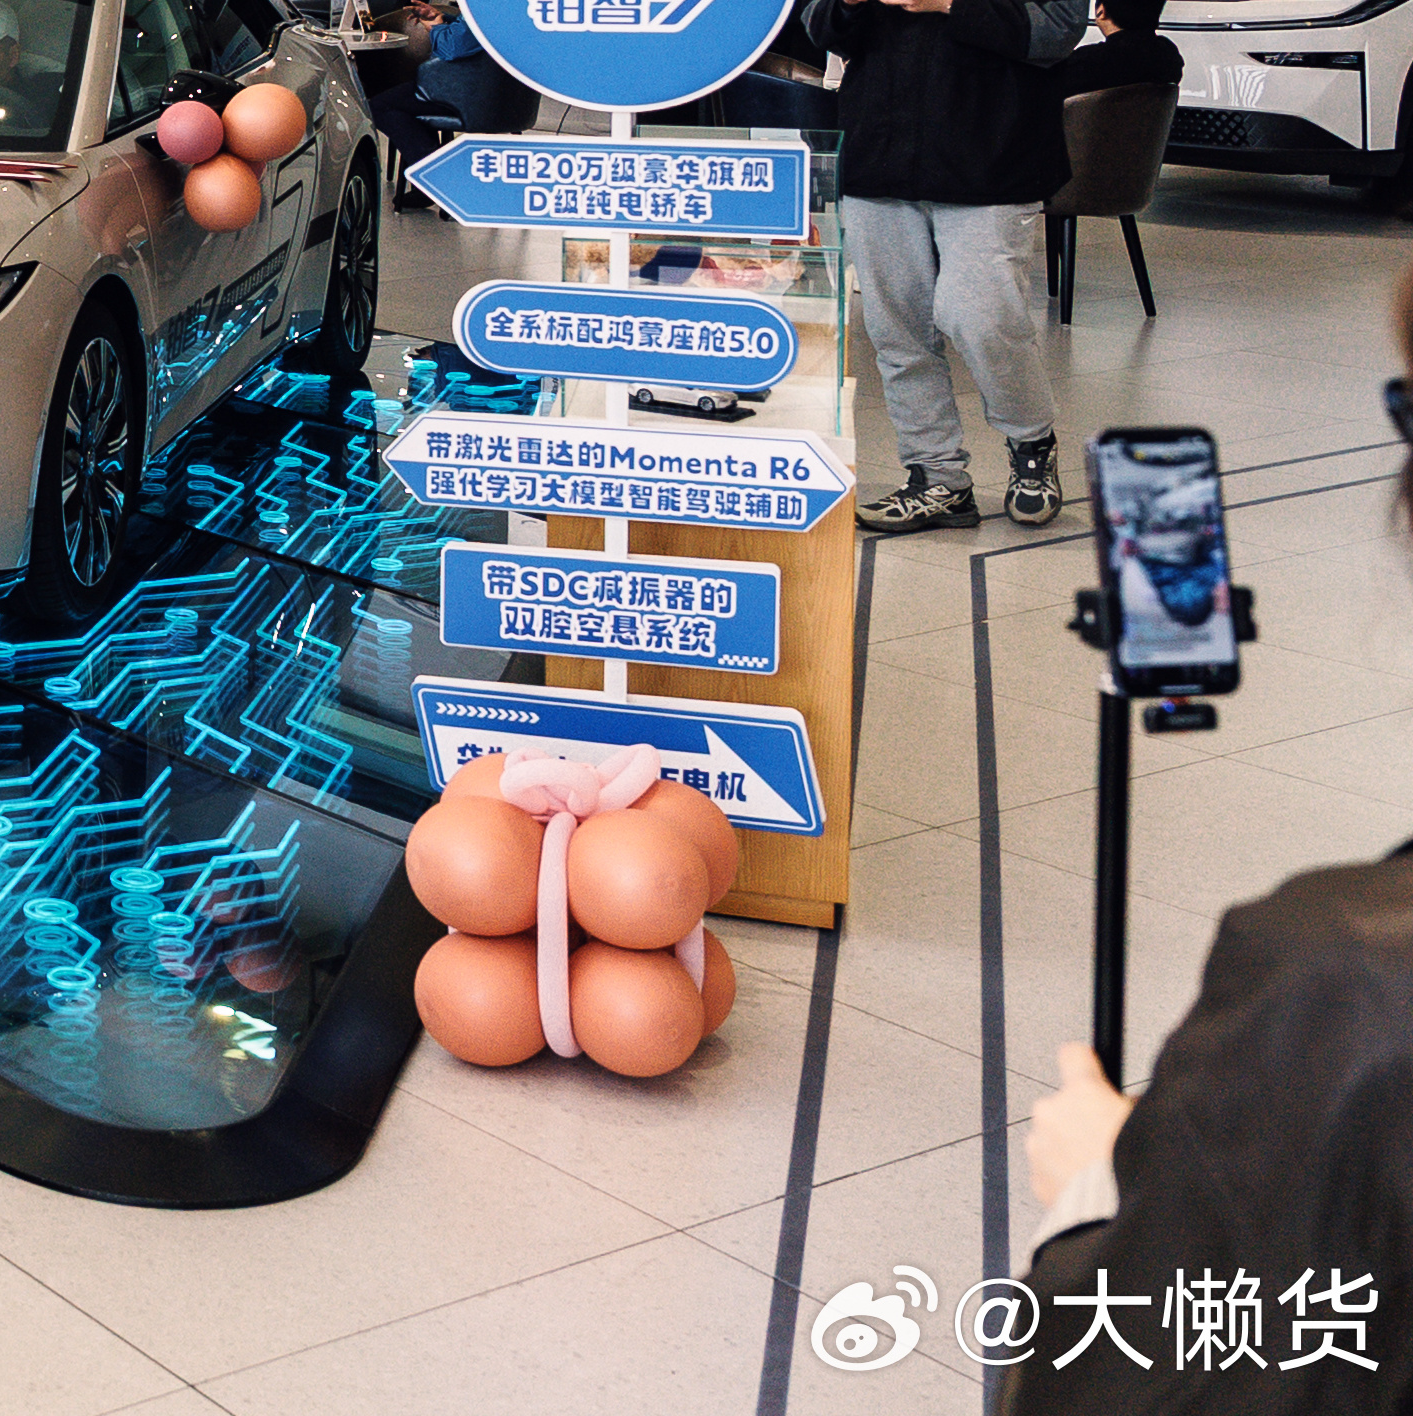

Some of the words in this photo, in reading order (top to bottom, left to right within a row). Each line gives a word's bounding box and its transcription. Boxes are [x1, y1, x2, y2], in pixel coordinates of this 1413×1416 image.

[472, 151, 773, 191] 丰田20万级豪华旗舰
[525, 190, 711, 222] D级纯电轿车
[486, 313, 777, 355] 全系标配鸿蒙座舱5.0
[426, 430, 758, 480] 带激光雷达的Momenta
[770, 456, 811, 482] R6
[429, 469, 805, 522] 强化学习大模型智能驾驶辅助
[485, 564, 734, 614] 带SDC减振器的
[502, 604, 715, 655] 双腔空悬系统
